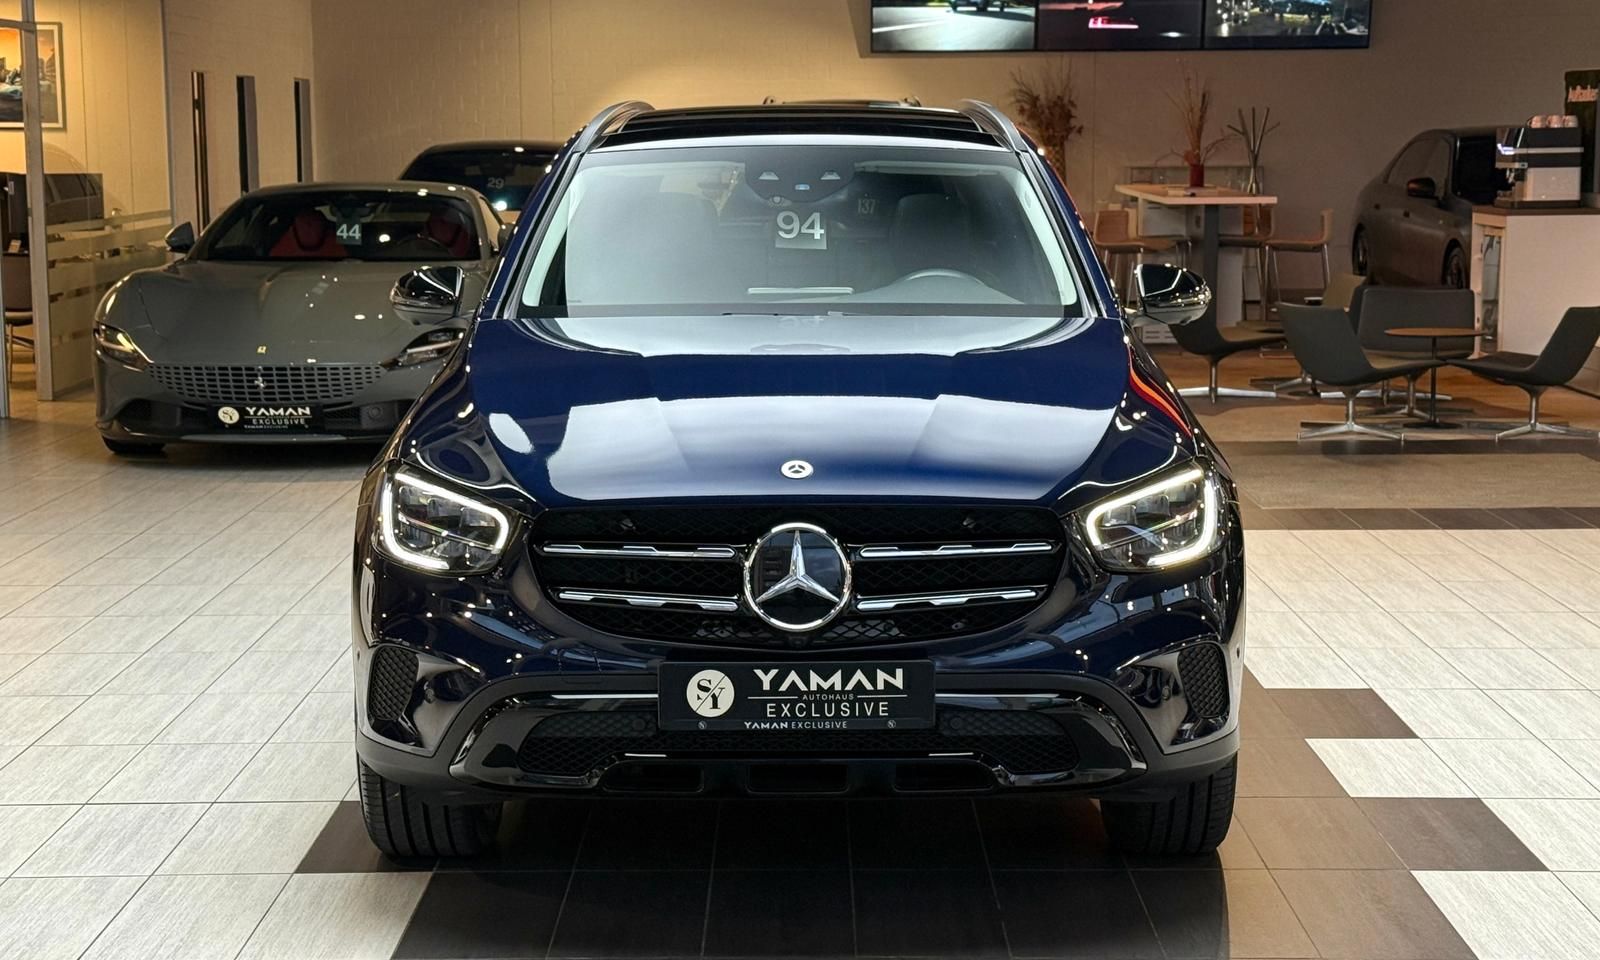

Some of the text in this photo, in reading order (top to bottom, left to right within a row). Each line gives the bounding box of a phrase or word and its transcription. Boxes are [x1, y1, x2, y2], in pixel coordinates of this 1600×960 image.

[488, 177, 505, 189] 29
[336, 223, 361, 240] 44
[776, 211, 825, 240] 94
[246, 406, 310, 416] YAMAN
[753, 668, 904, 691] YAMAN
[802, 692, 855, 701] AUTOHAUS
[766, 702, 889, 718] EXCLUSIVE
[744, 720, 848, 729] YAMAN EXCLUSIVE
